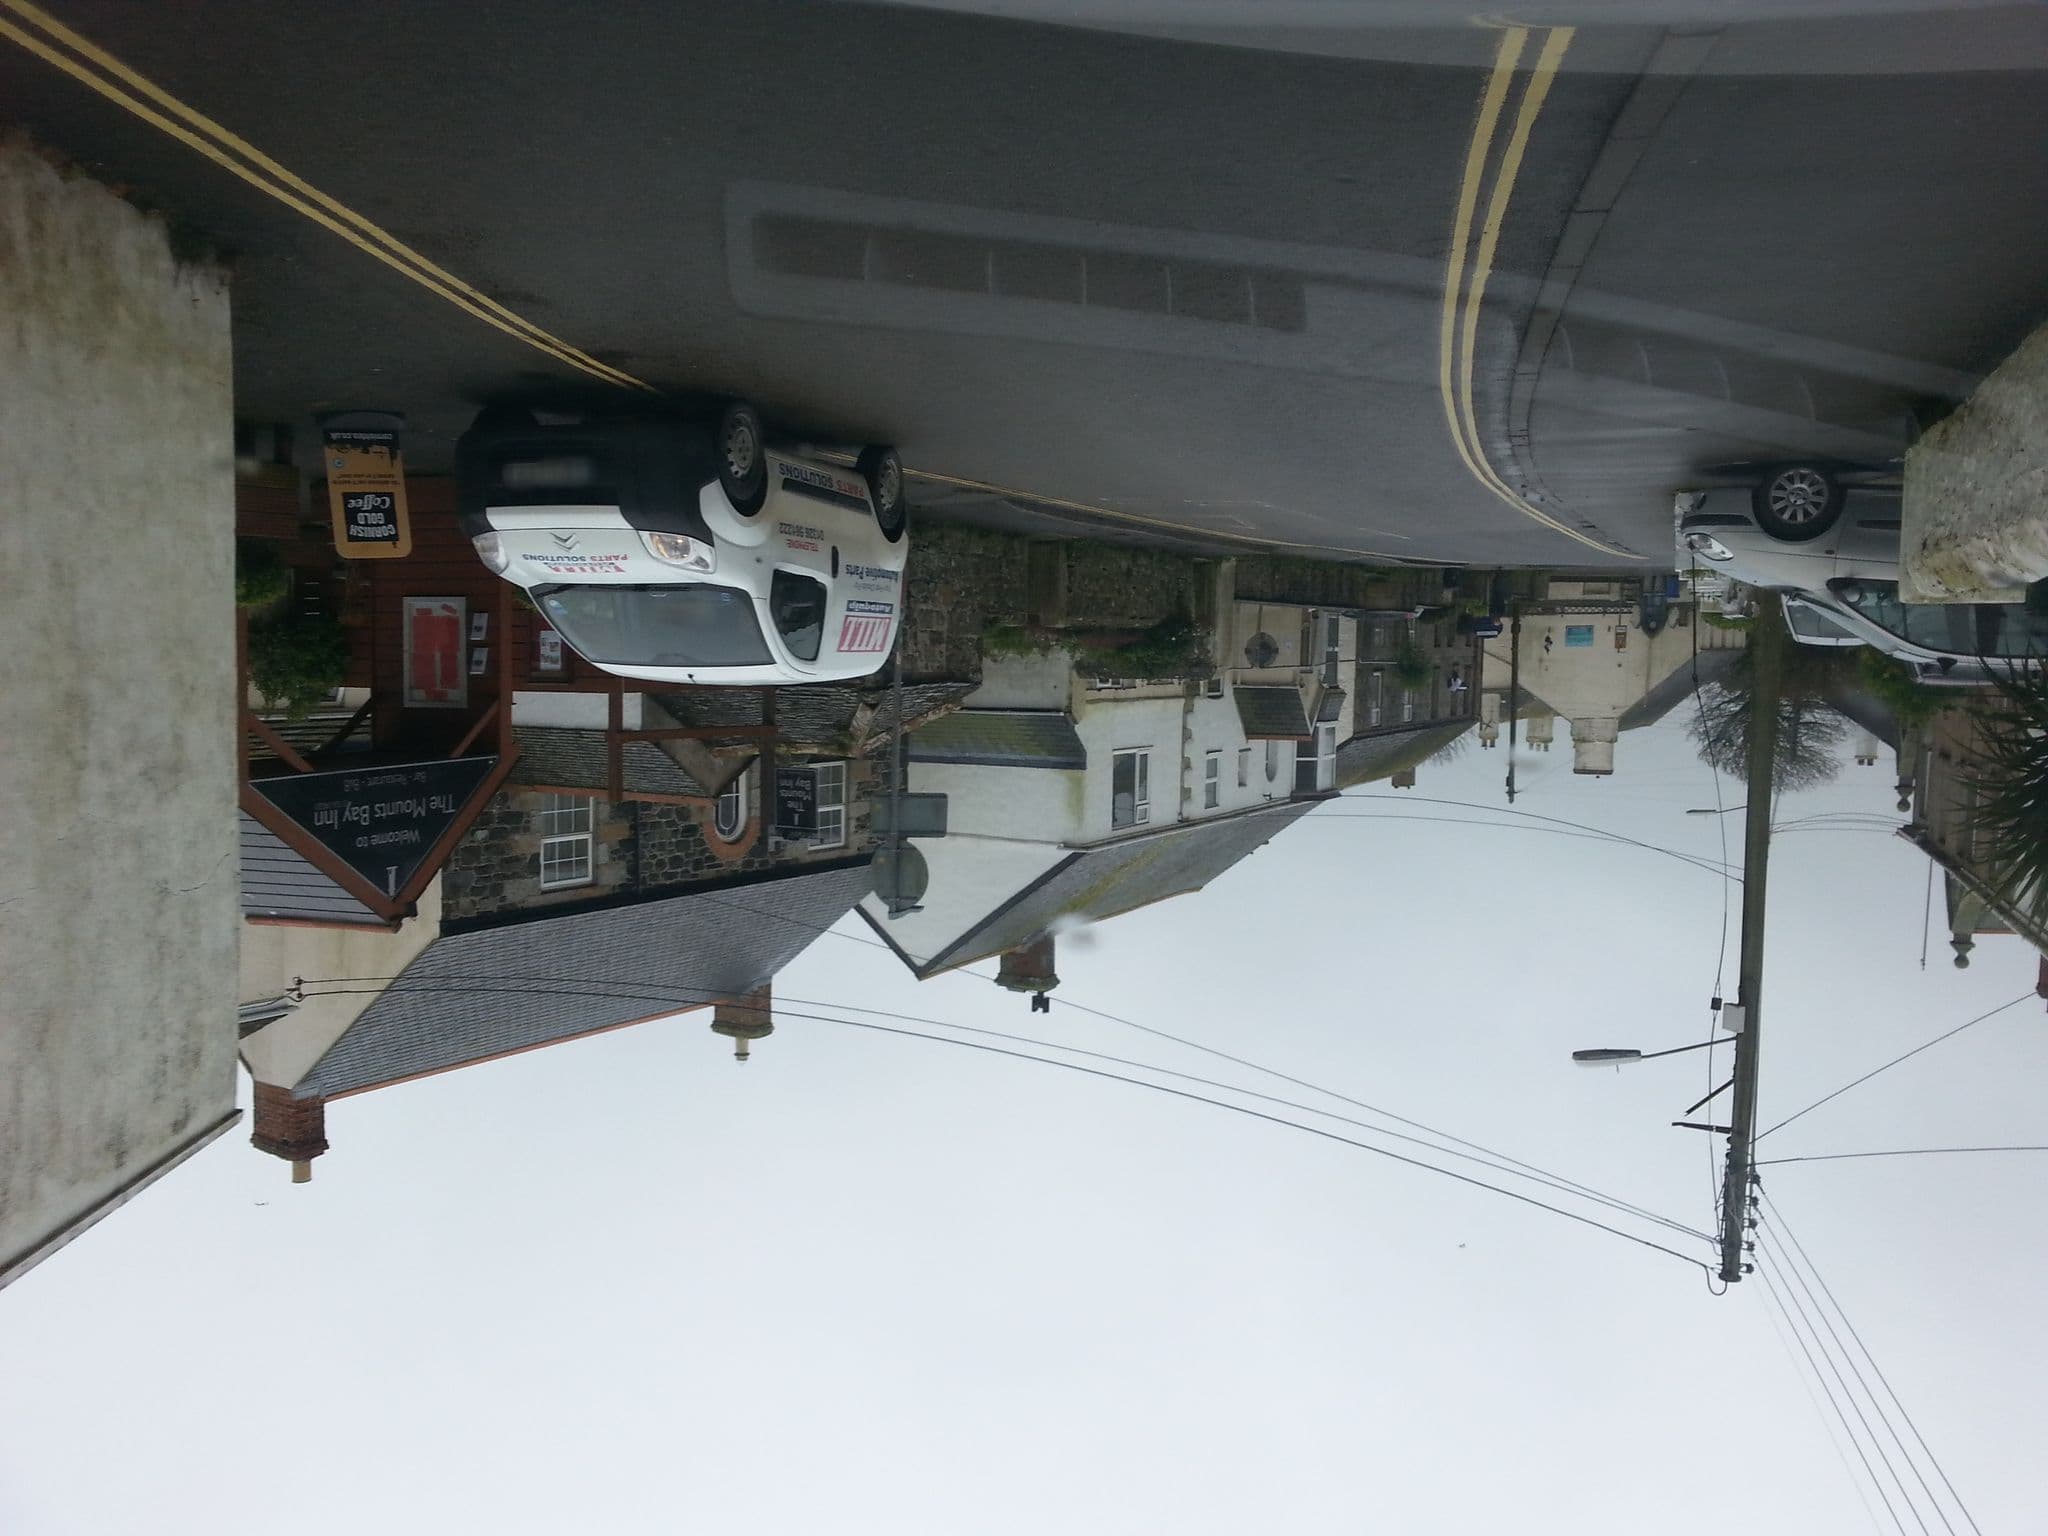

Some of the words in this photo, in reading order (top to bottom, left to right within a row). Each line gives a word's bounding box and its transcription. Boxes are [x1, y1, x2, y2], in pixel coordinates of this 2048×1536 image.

[778, 463, 834, 489] SOLUTIONS
[836, 480, 864, 498] PARTS
[347, 494, 390, 510] Coffee
[356, 512, 385, 524] GOLD
[348, 524, 396, 538] CORNISH
[522, 554, 586, 562] SOLUTIONS
[590, 554, 628, 562] PARTS
[845, 564, 864, 579] Parts
[848, 600, 892, 614] Autoquip
[838, 616, 891, 651] MILL
[778, 778, 792, 789] Inn
[793, 776, 812, 790] Bay
[779, 790, 812, 800] Mounts
[374, 798, 426, 819] Mounts
[430, 794, 456, 814] The
[786, 800, 805, 812] The
[313, 809, 339, 830] Inn
[342, 801, 370, 826] Bay
[356, 836, 369, 848] to
[370, 830, 420, 846] Welcome
